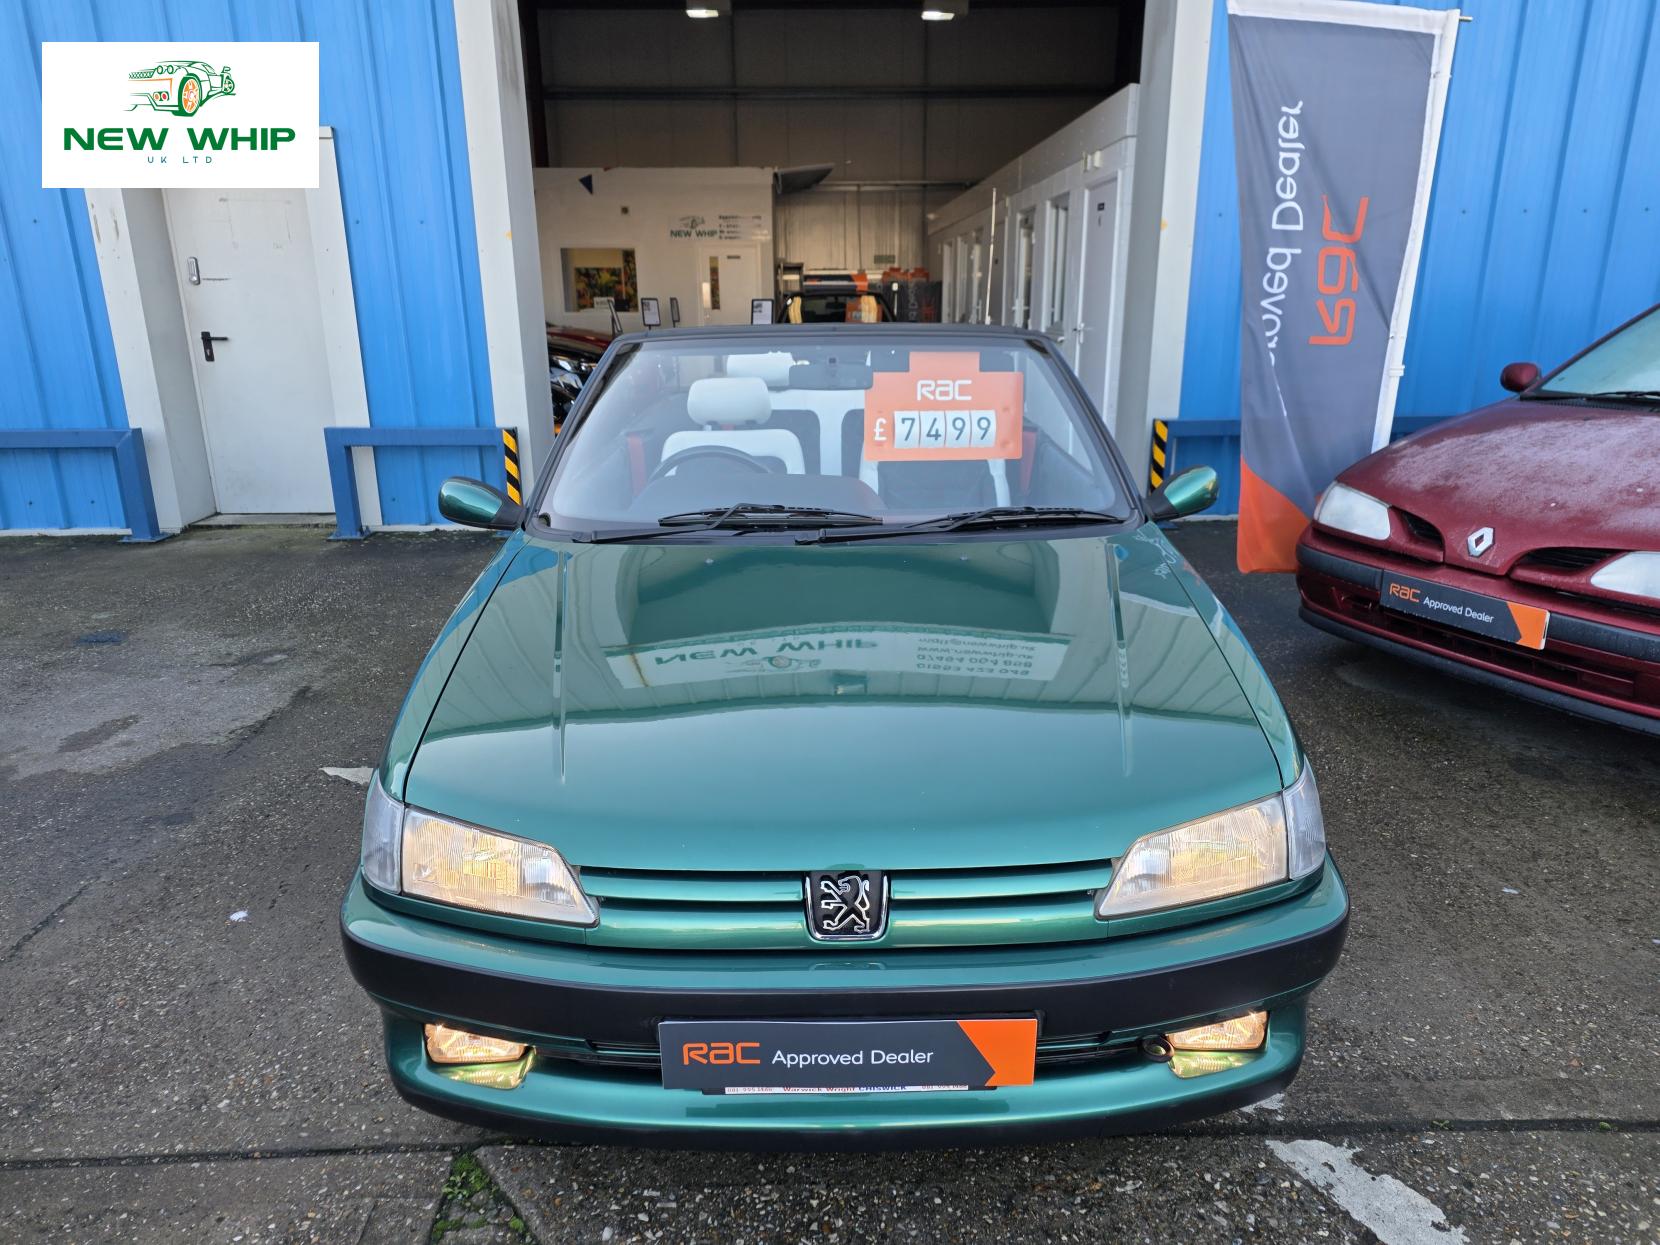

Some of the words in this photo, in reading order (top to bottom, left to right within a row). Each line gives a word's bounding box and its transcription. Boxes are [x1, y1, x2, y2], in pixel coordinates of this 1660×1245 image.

[670, 229, 691, 238] NEW
[1423, 596, 1464, 615] Approved
[1464, 607, 1495, 624] Dealer
[772, 1049, 863, 1069] Approved
[870, 1049, 934, 1065] Dealer
